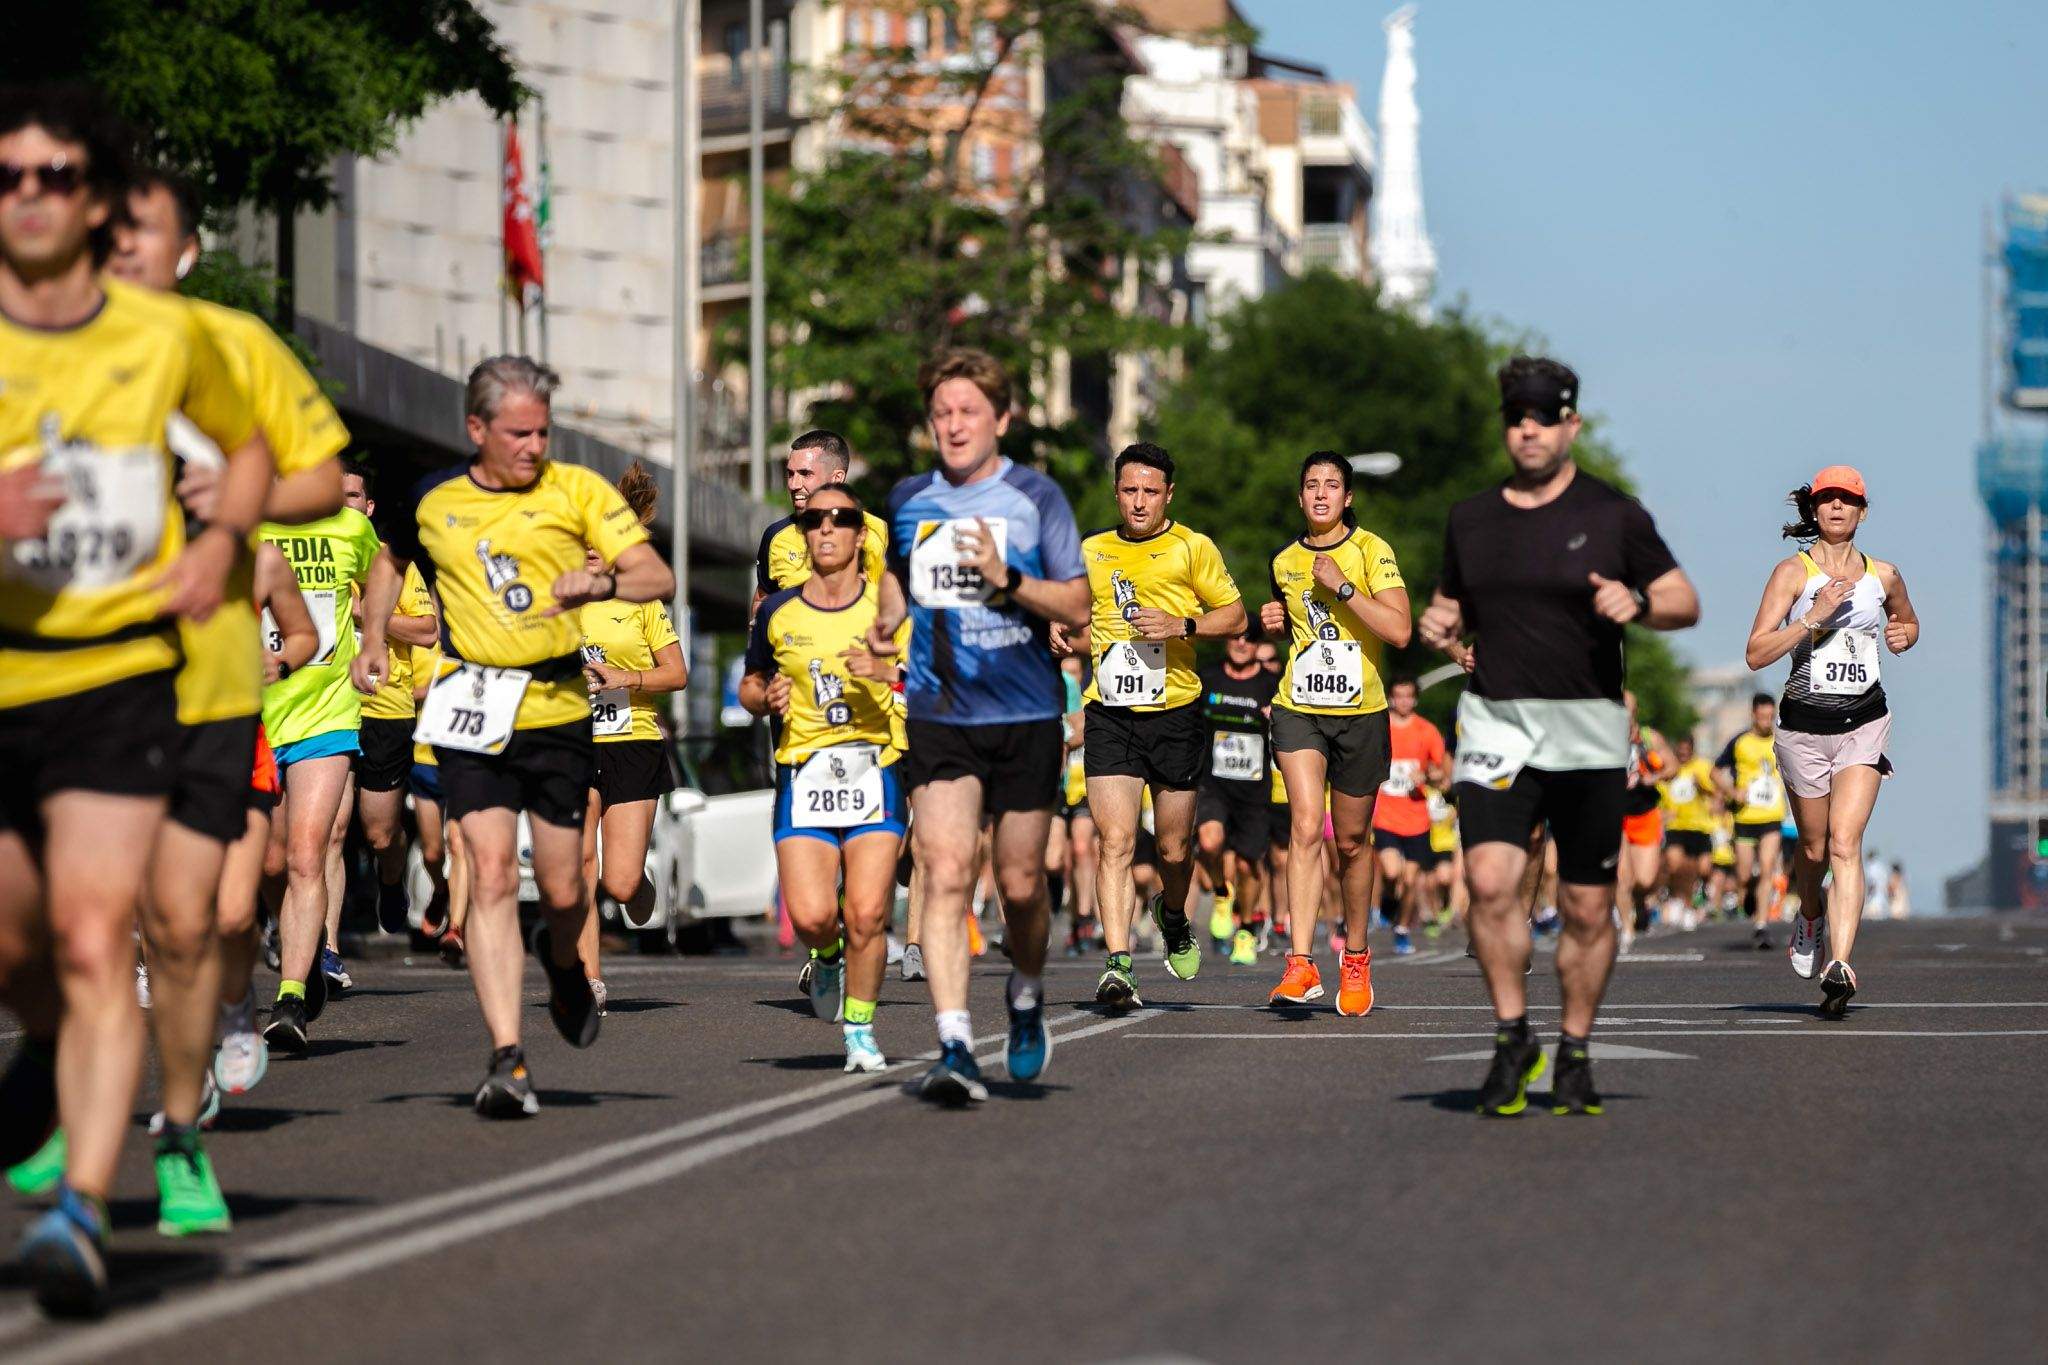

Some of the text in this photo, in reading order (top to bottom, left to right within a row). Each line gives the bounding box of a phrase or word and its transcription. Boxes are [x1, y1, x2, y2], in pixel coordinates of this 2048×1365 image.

[264, 537, 334, 562] EDIA
[1322, 627, 1337, 640] 13
[1826, 662, 1867, 683] 3795
[1115, 674, 1144, 694] 791
[1305, 673, 1347, 694] 1848
[447, 707, 485, 736] 773
[829, 706, 849, 723] 13
[807, 788, 865, 812] 2869
